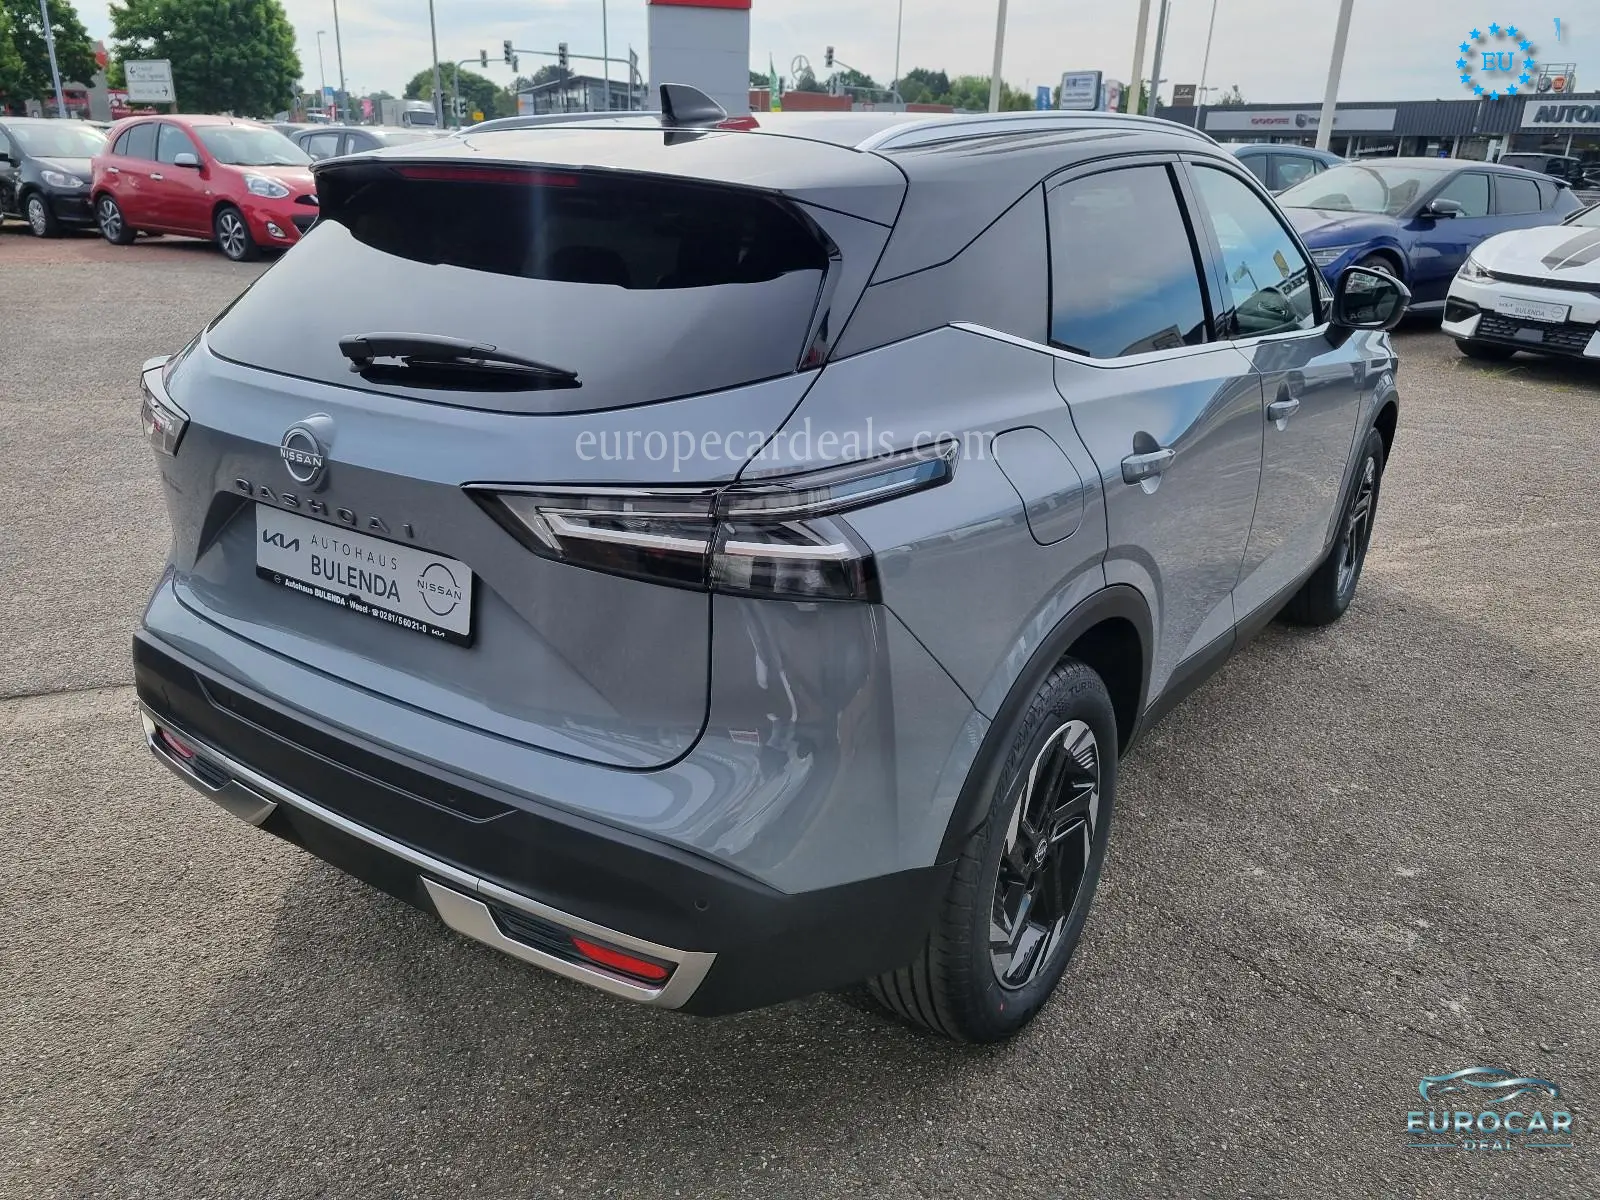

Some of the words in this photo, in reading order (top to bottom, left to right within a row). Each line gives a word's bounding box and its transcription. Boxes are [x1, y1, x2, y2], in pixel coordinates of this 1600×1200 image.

[280, 448, 323, 467] NISSAN
[234, 477, 416, 540] QASHQAI
[311, 534, 399, 571] AUTOHAUS
[284, 578, 314, 596] Autohaus
[314, 588, 346, 606] BULENDA
[349, 600, 369, 614] Wesel
[311, 554, 401, 603] BULENDA
[417, 578, 462, 601] NISSAN
